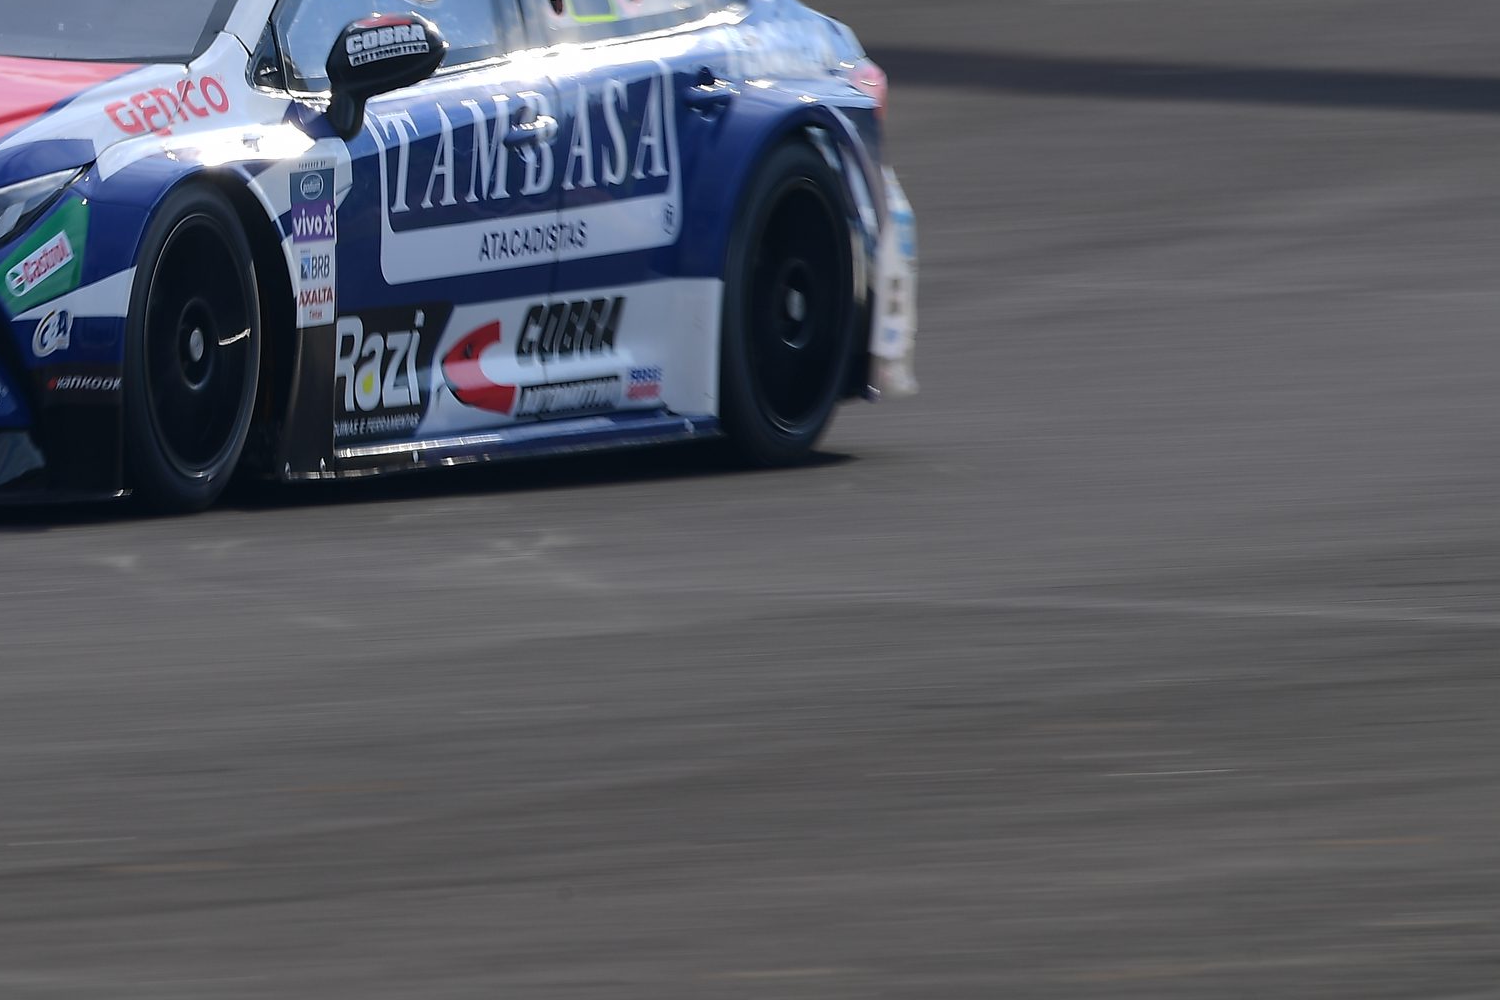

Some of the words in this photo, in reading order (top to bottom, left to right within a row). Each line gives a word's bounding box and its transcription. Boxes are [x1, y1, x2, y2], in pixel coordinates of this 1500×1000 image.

[345, 23, 426, 54] COBRA
[376, 75, 670, 214] TAMBASA
[292, 208, 323, 237] vivo
[478, 220, 589, 262] ATACADISTAS
[311, 255, 331, 280] BRB
[335, 309, 425, 412] Razi
